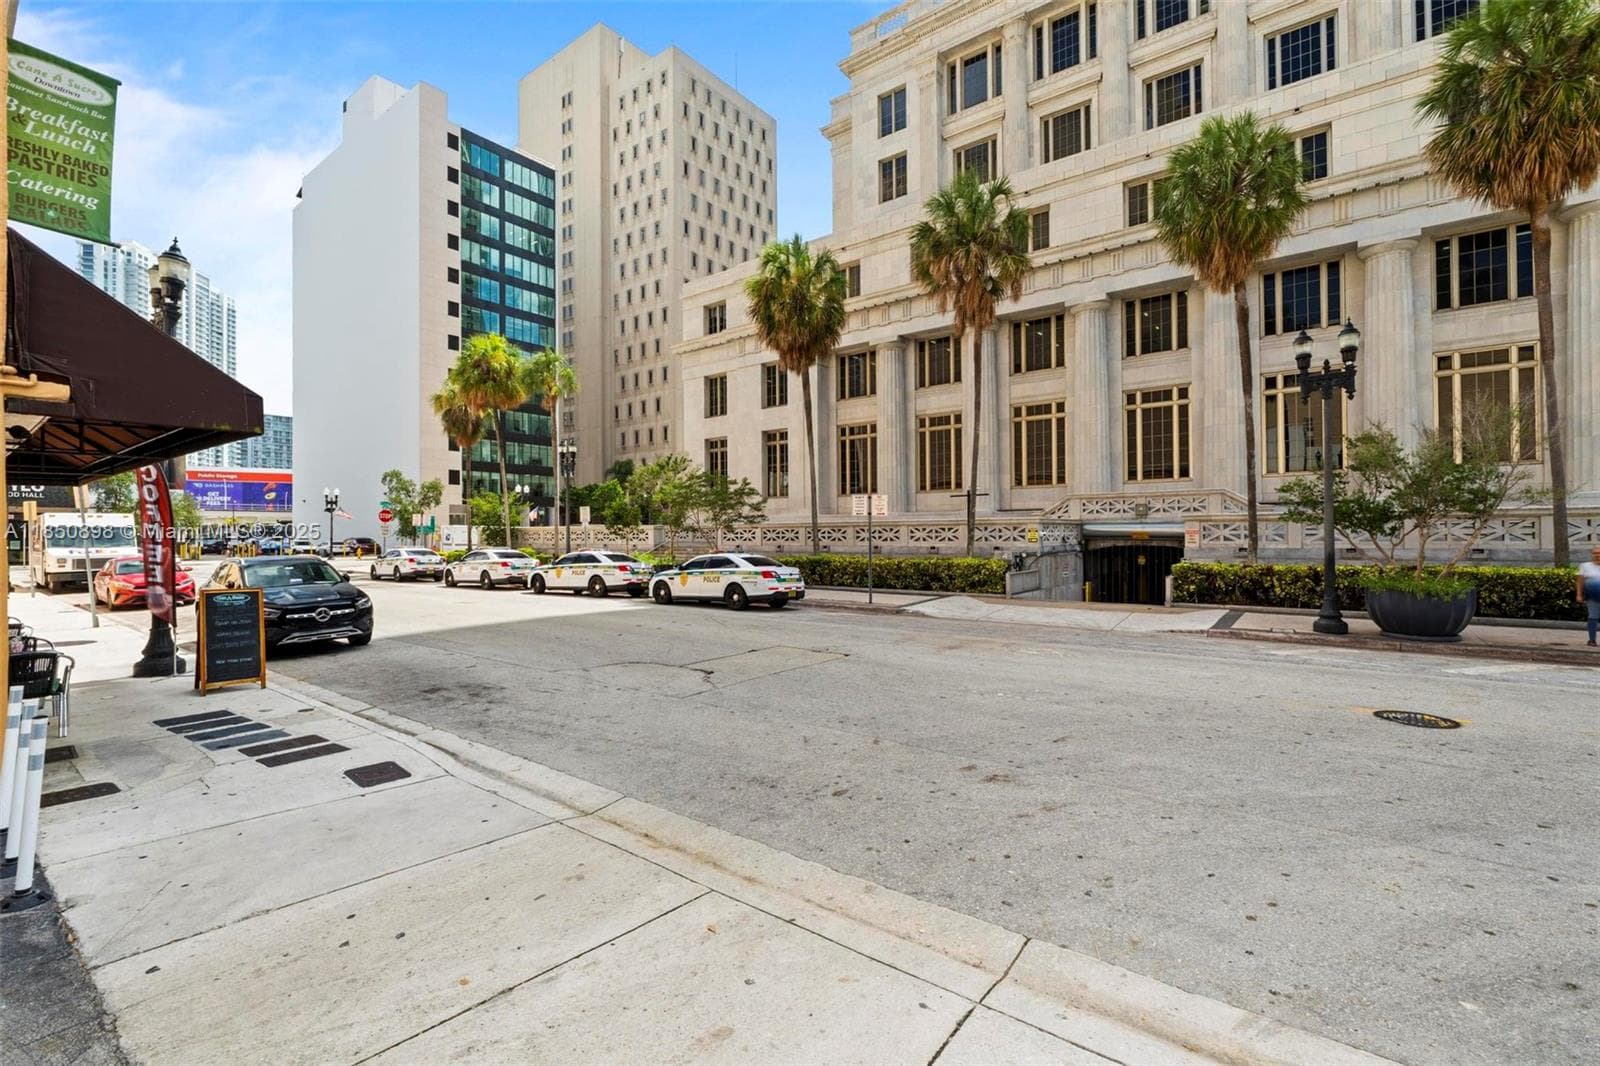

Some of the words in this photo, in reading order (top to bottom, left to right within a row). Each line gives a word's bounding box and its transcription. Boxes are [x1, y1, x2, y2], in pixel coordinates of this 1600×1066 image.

[17, 60, 48, 77] Cane
[33, 76, 81, 98] Downtown
[7, 95, 108, 143] Breakfast
[90, 110, 107, 120] Bar
[11, 113, 26, 125] &
[24, 120, 96, 154] Lunch
[7, 149, 98, 187] PASTRIES
[62, 153, 109, 177] BAKED
[7, 169, 99, 210] Catering
[14, 204, 87, 232] SALADS
[15, 192, 87, 220] BURGERS
[702, 575, 721, 584] POLICE
